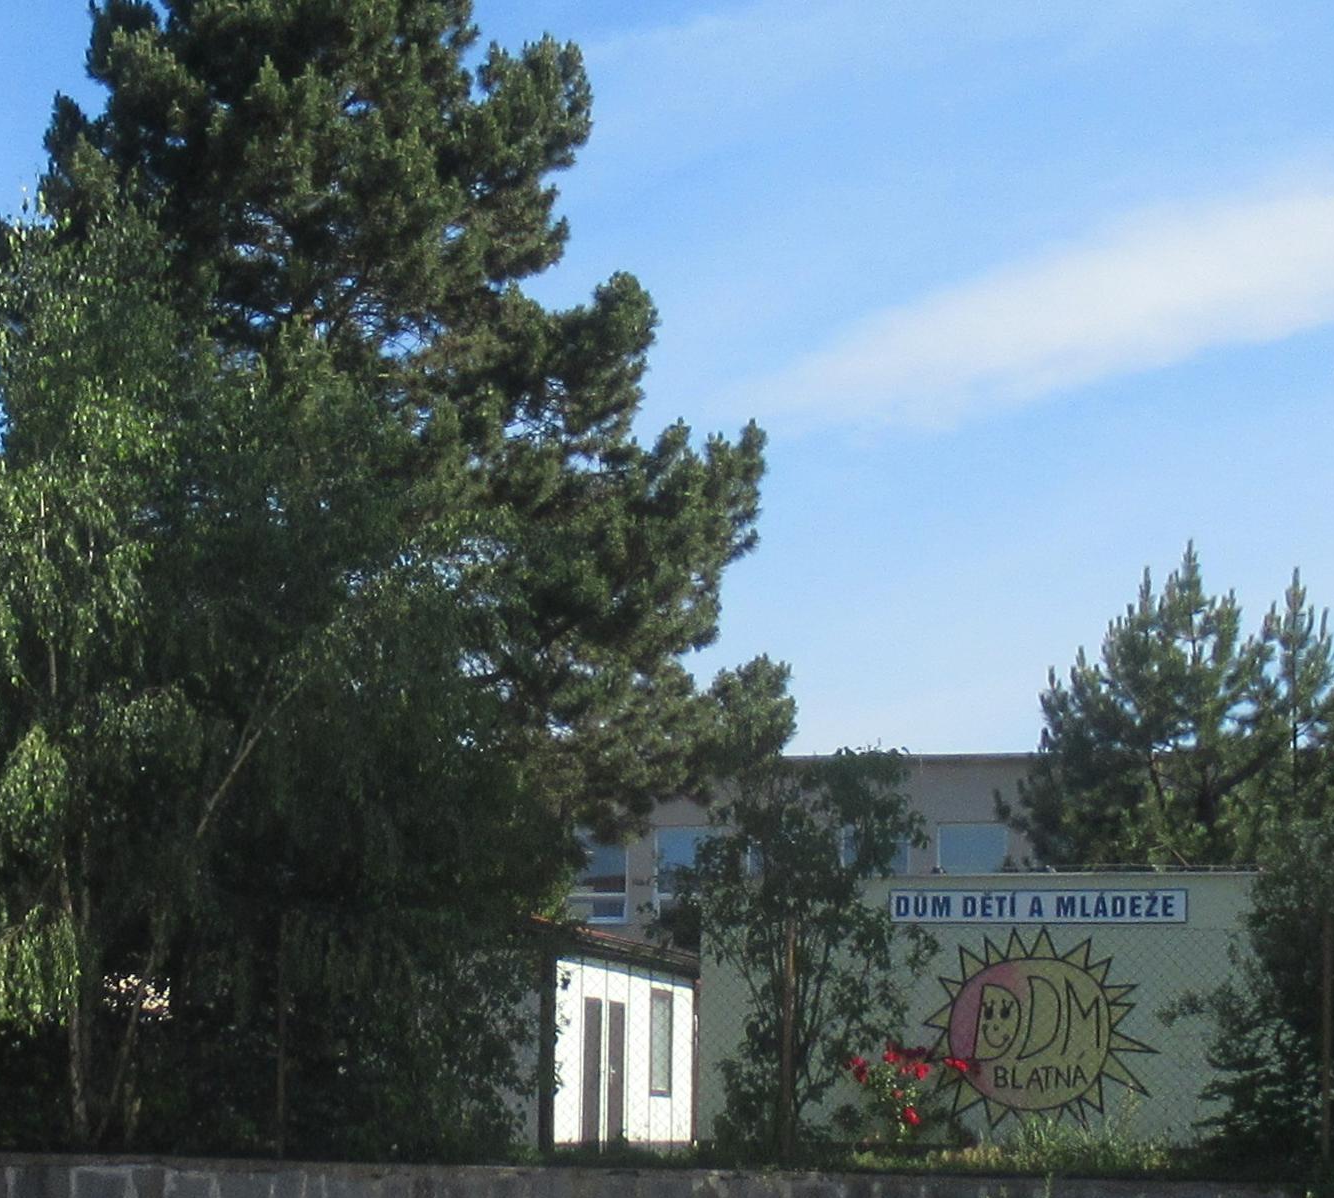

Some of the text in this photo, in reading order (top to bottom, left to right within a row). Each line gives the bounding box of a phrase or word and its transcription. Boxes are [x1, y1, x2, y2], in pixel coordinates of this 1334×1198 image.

[962, 889, 1016, 917] DĚTÍ
[1028, 896, 1044, 917] A
[1055, 891, 1175, 918] MLÁDEŽE
[993, 1051, 1089, 1094] BLATNÁ
